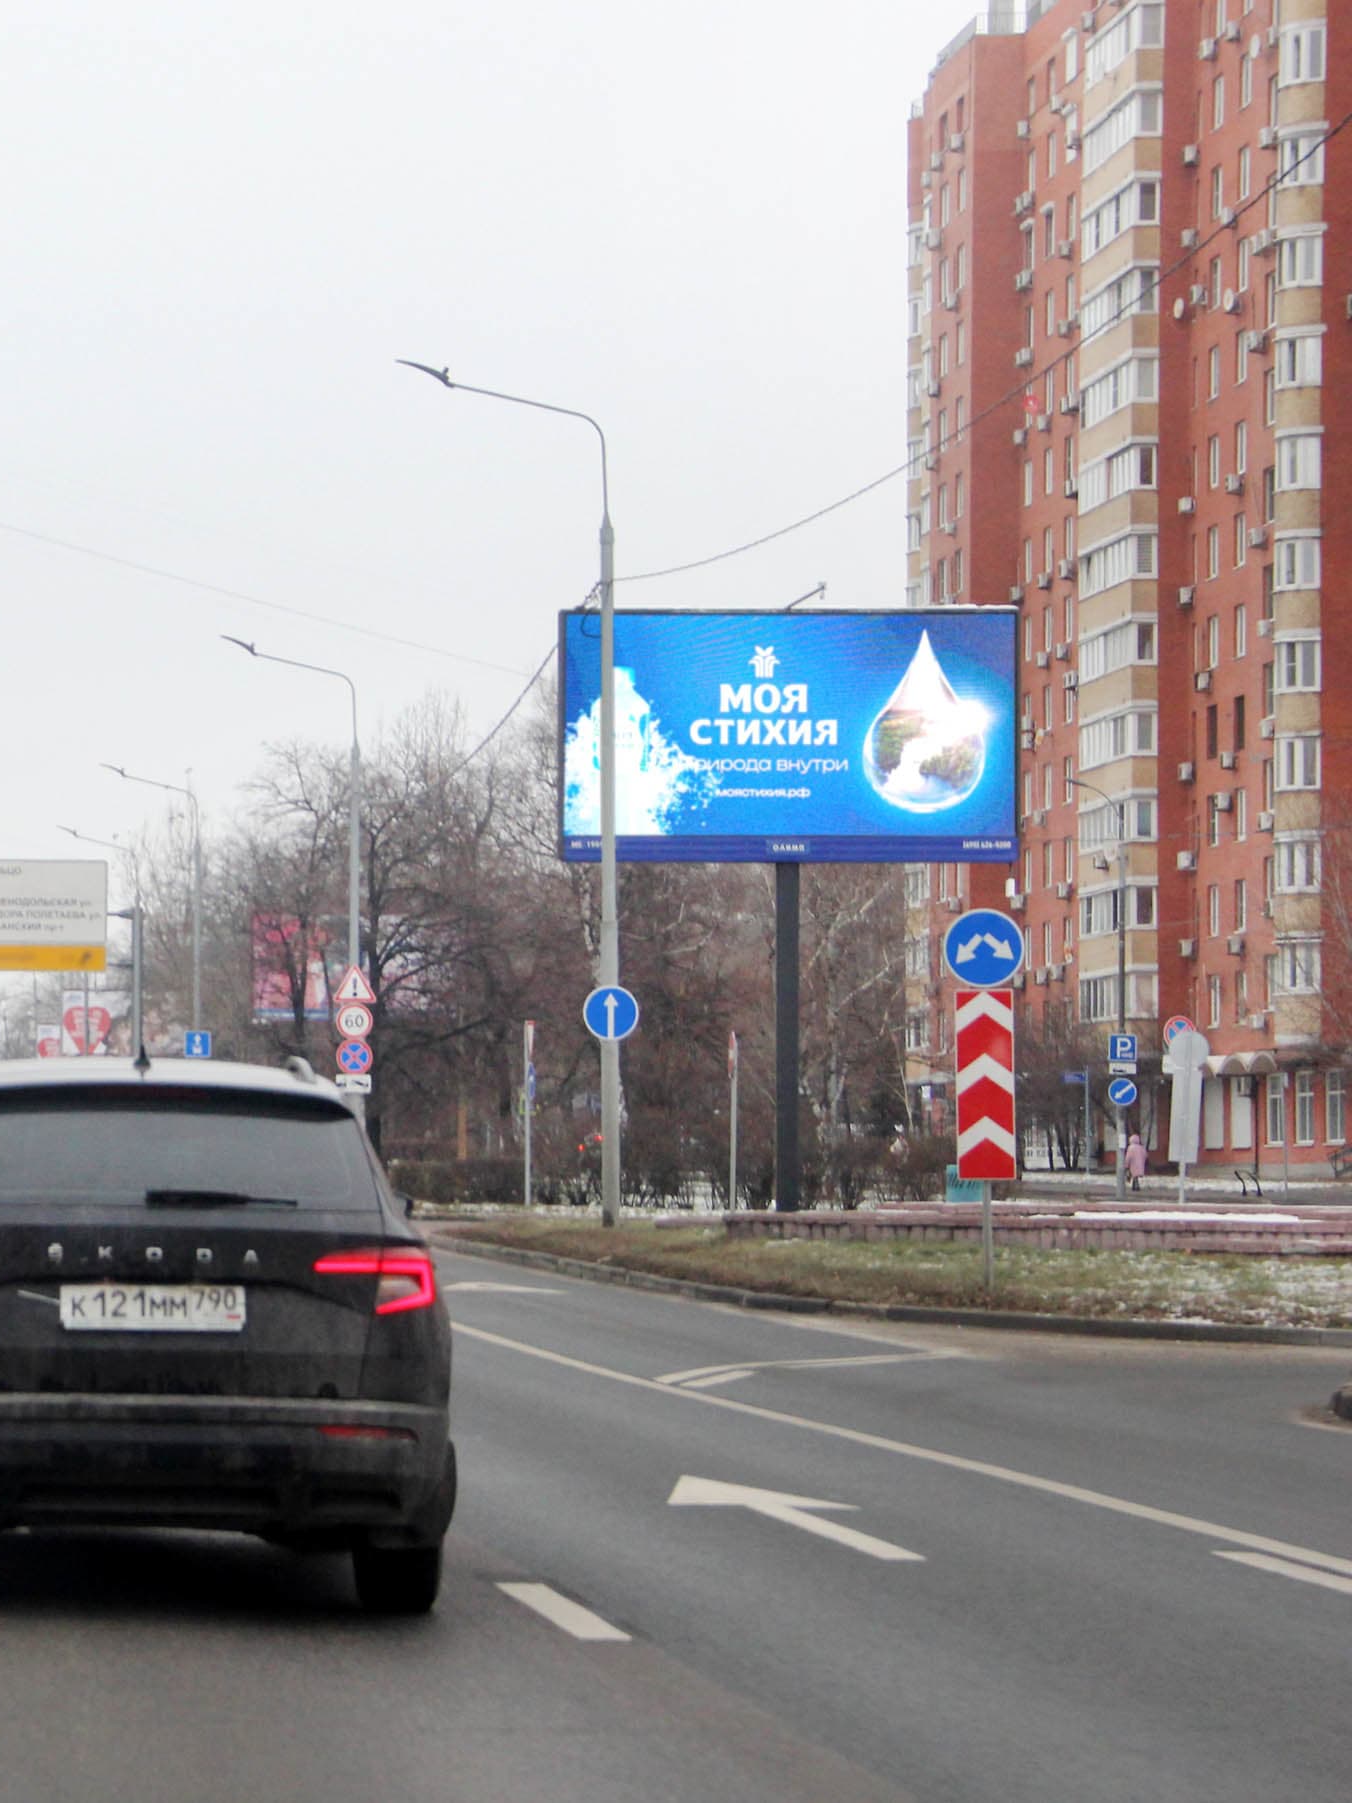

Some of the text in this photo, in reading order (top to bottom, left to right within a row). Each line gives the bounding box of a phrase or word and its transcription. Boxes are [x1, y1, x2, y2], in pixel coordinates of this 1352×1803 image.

[719, 683, 808, 714] МОЯ
[689, 718, 838, 745] СТИХИЯ
[684, 758, 849, 774] рирода внутри
[345, 1014, 364, 1028] 60
[1116, 1037, 1132, 1059] P
